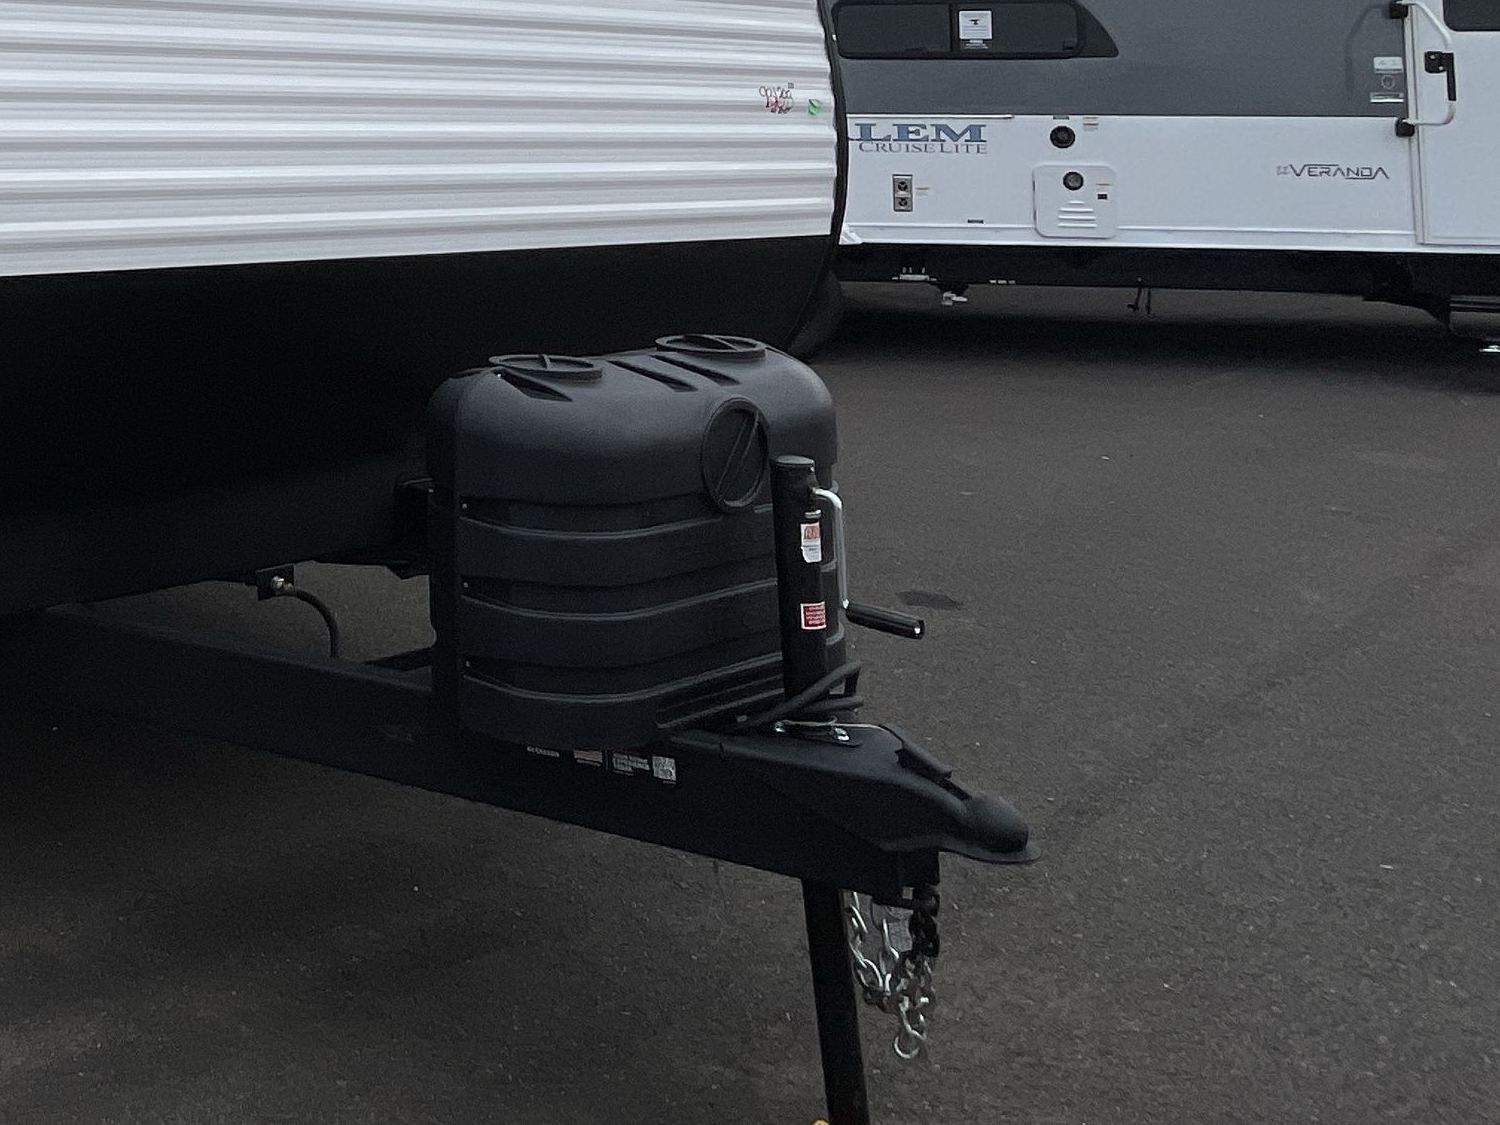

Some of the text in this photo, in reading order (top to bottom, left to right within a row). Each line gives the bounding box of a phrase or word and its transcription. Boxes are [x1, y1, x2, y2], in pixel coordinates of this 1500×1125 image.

[848, 122, 988, 143] LEM
[858, 141, 988, 155] CRUISE LITE
[1288, 163, 1391, 180] VERANDA
